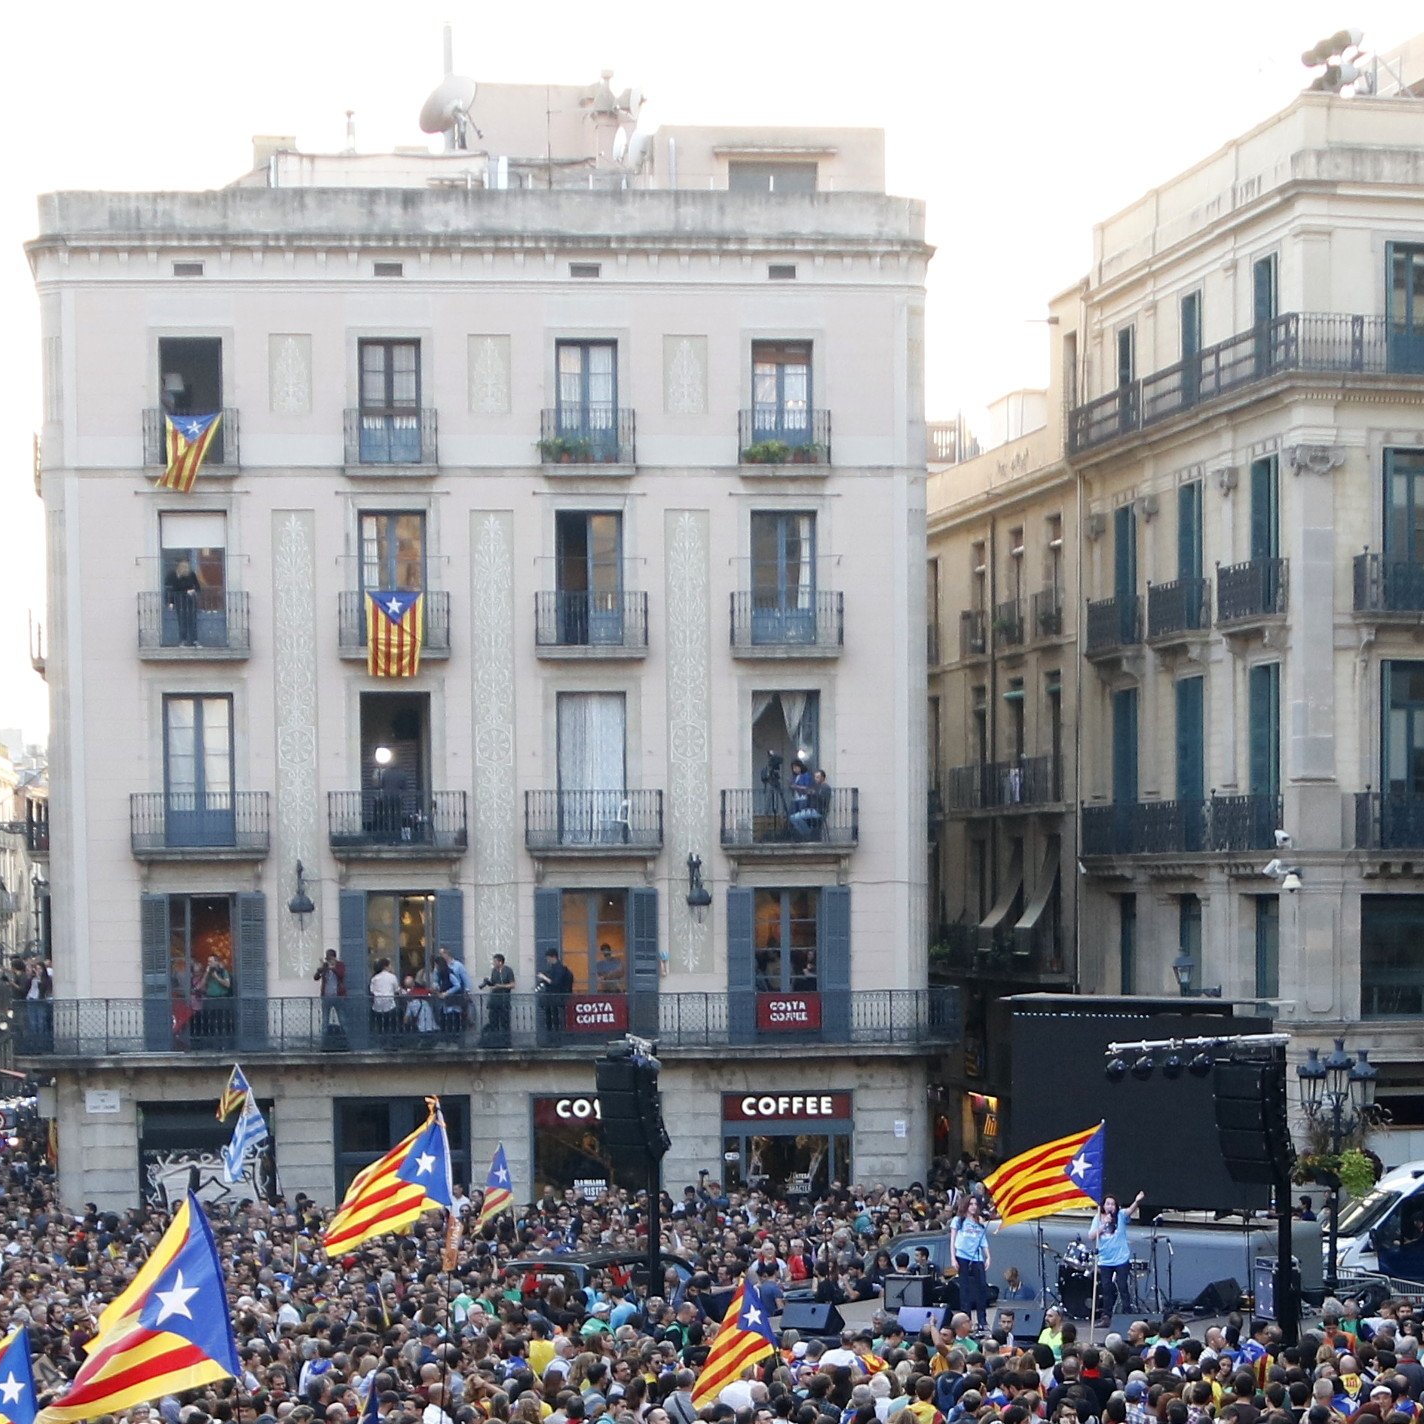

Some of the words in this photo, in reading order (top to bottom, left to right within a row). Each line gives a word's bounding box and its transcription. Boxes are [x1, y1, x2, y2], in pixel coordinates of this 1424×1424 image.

[576, 1003, 613, 1012] COSTA
[769, 1001, 806, 1011] COSTA
[576, 1013, 615, 1024] COFFEE
[741, 1096, 833, 1116] COFFEE
